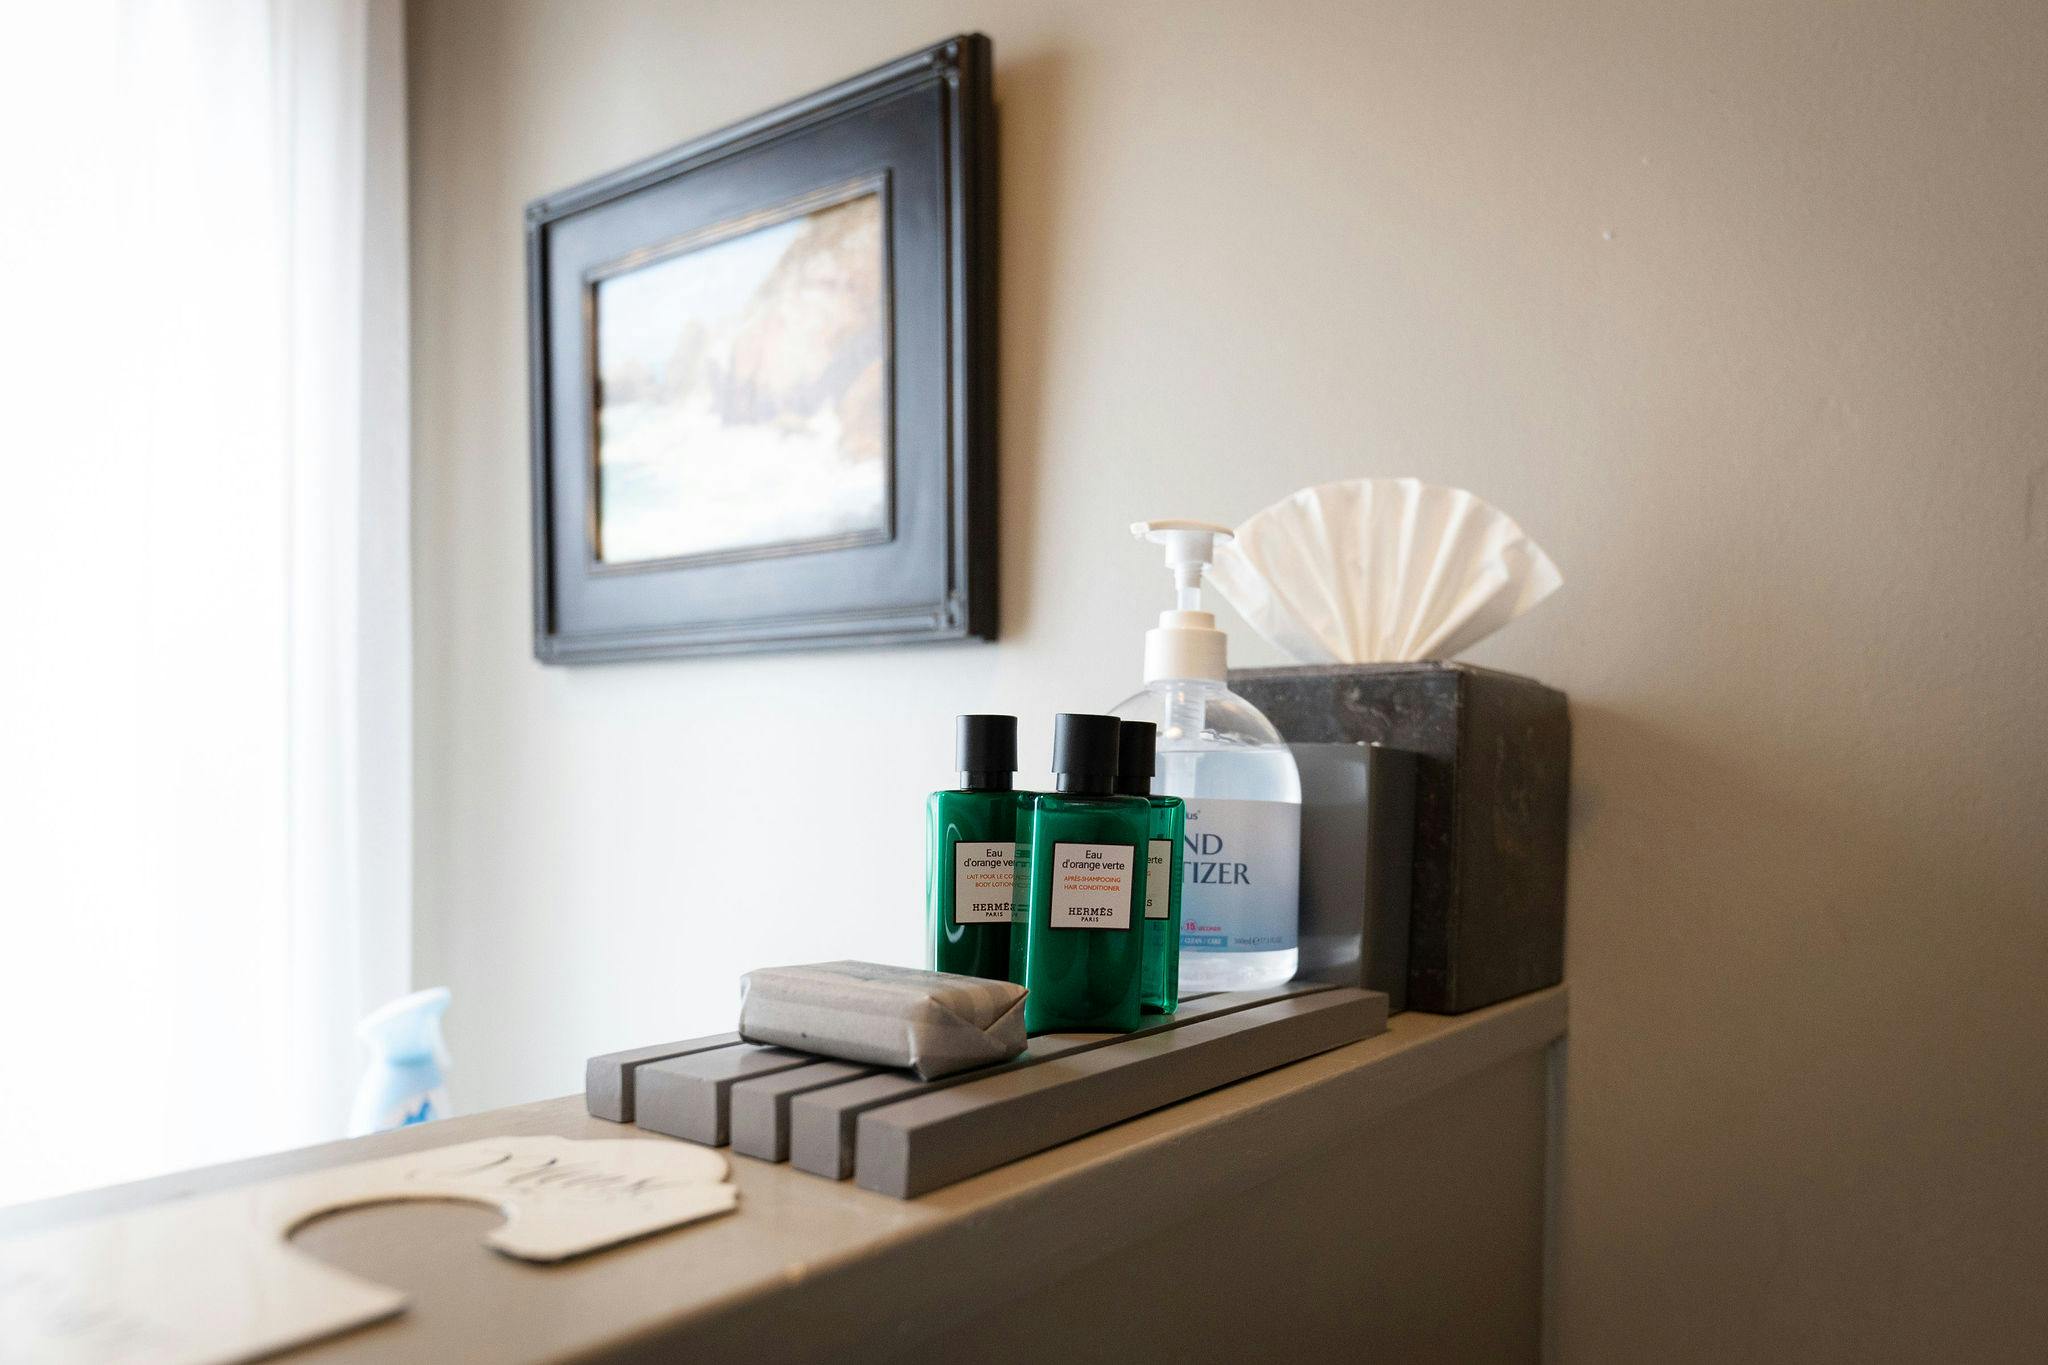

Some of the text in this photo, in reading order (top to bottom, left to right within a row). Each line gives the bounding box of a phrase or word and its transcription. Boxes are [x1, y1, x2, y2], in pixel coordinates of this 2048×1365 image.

[1184, 833, 1224, 855] ND
[986, 848, 1003, 858] Eau
[1085, 850, 1103, 859] Eau
[963, 858, 1002, 869] d'orange
[1062, 859, 1125, 871] d'orange verte
[1147, 857, 1163, 865] erte
[1079, 884, 1121, 892] CONDITIONER
